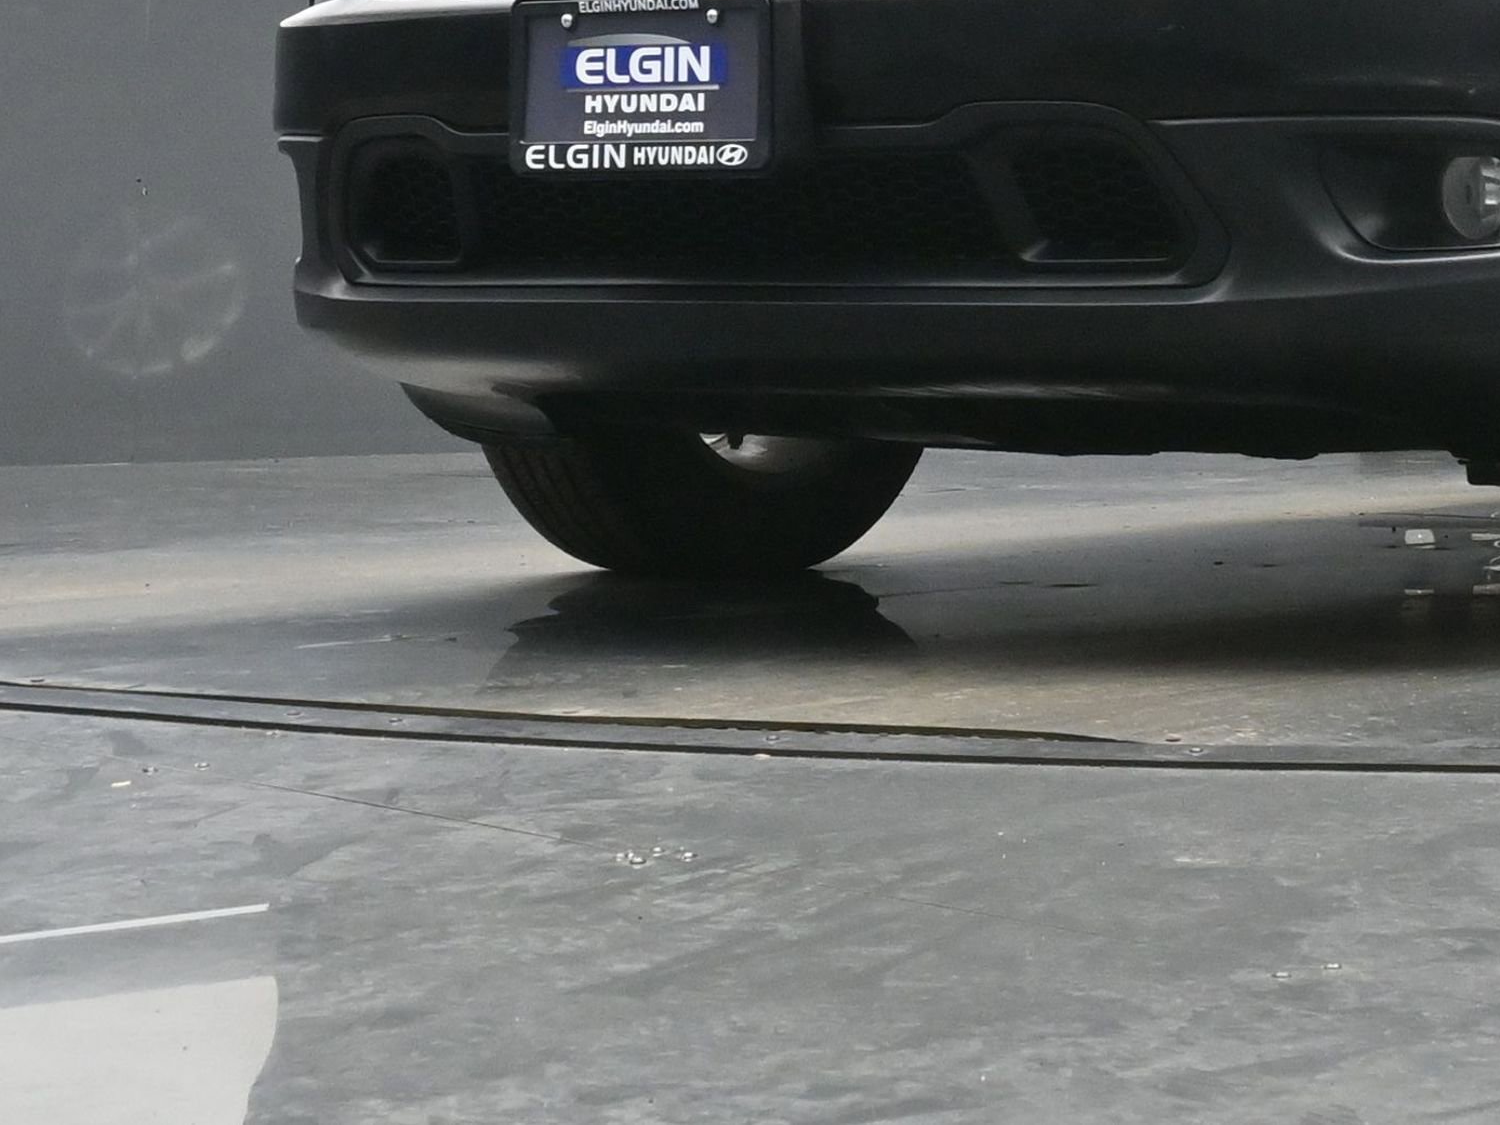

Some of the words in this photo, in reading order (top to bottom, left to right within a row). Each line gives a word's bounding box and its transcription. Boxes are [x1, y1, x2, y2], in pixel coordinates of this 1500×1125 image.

[575, 45, 710, 85] ELGIN
[584, 92, 705, 114] HYUNDAI
[583, 119, 704, 137] ElginHyundai.com
[525, 144, 626, 169] ELGIN
[633, 145, 714, 165] HYUNDAI
